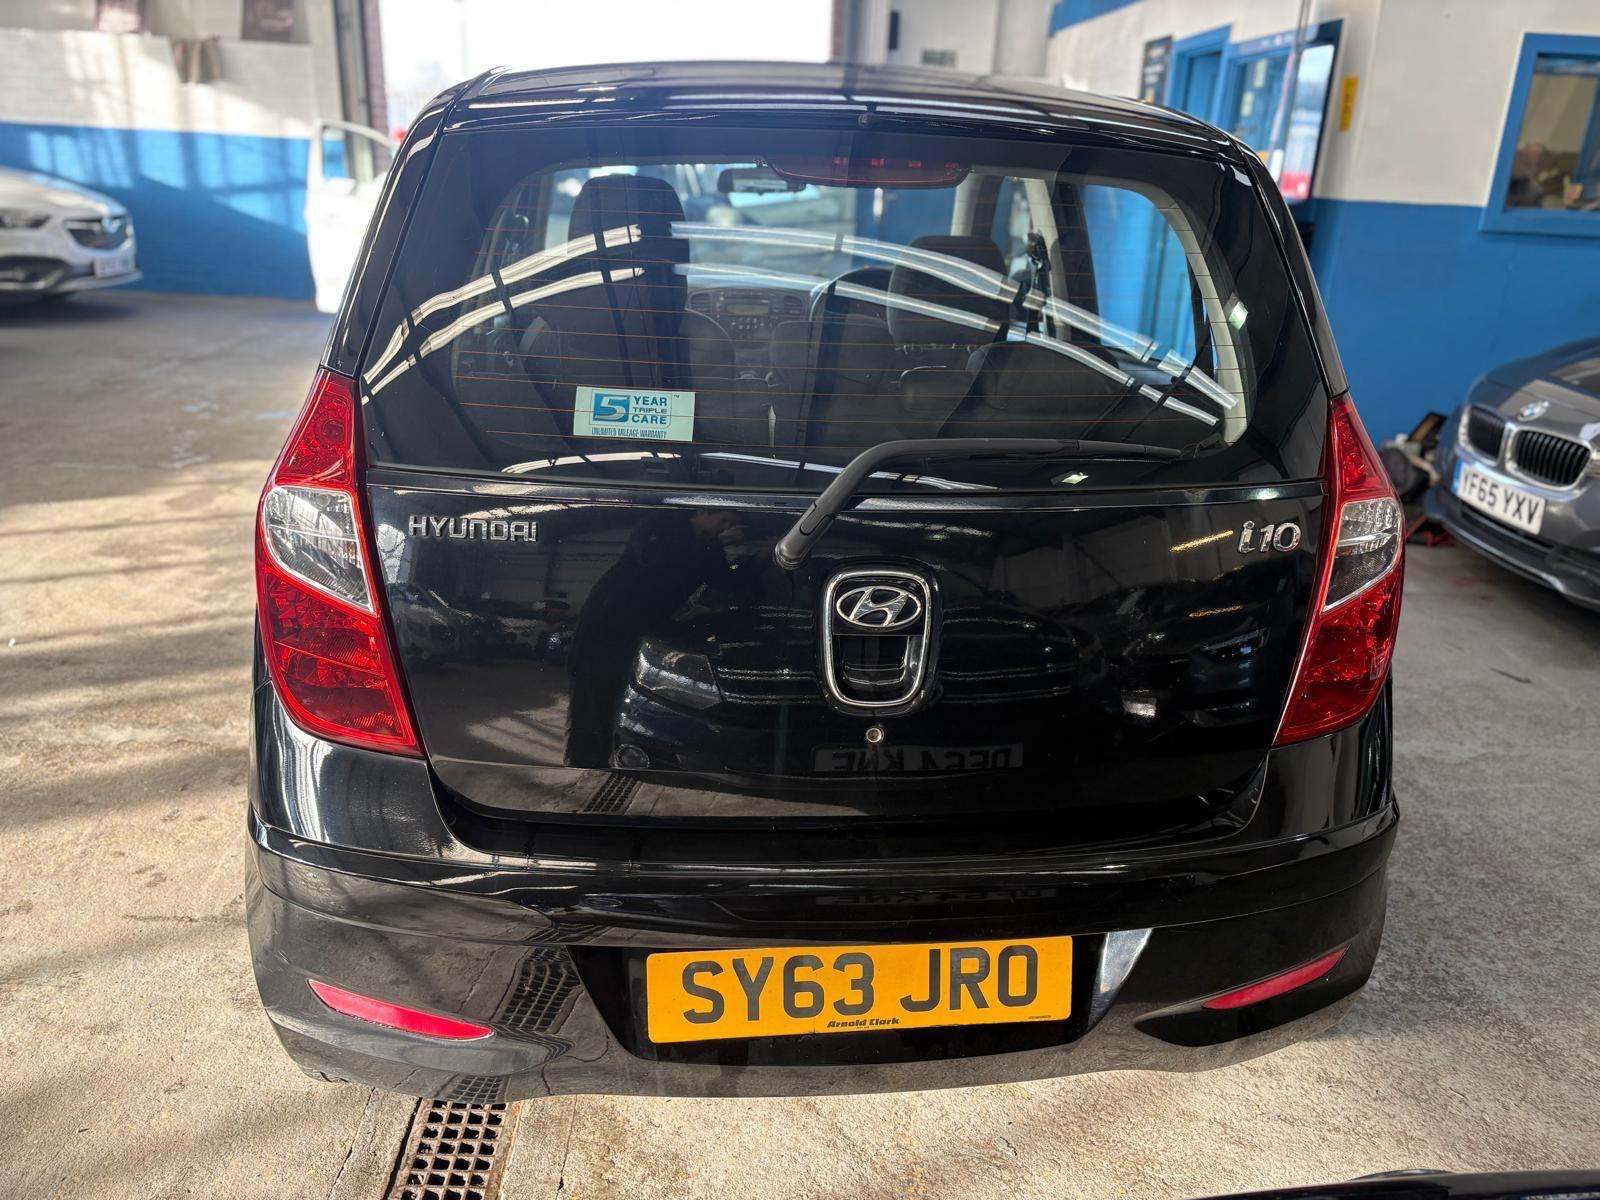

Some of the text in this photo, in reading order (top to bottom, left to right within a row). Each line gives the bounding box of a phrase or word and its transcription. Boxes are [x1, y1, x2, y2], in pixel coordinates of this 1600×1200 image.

[633, 395, 668, 407] YEAR
[594, 395, 626, 421] 5
[631, 415, 667, 425] CARE
[592, 427, 667, 440] UNLIMITED MILEAGE WARRANTY
[1503, 487, 1540, 526] YXV
[681, 944, 1039, 1024] SY63 JRO
[827, 1018, 900, 1028] Arnold Clark
